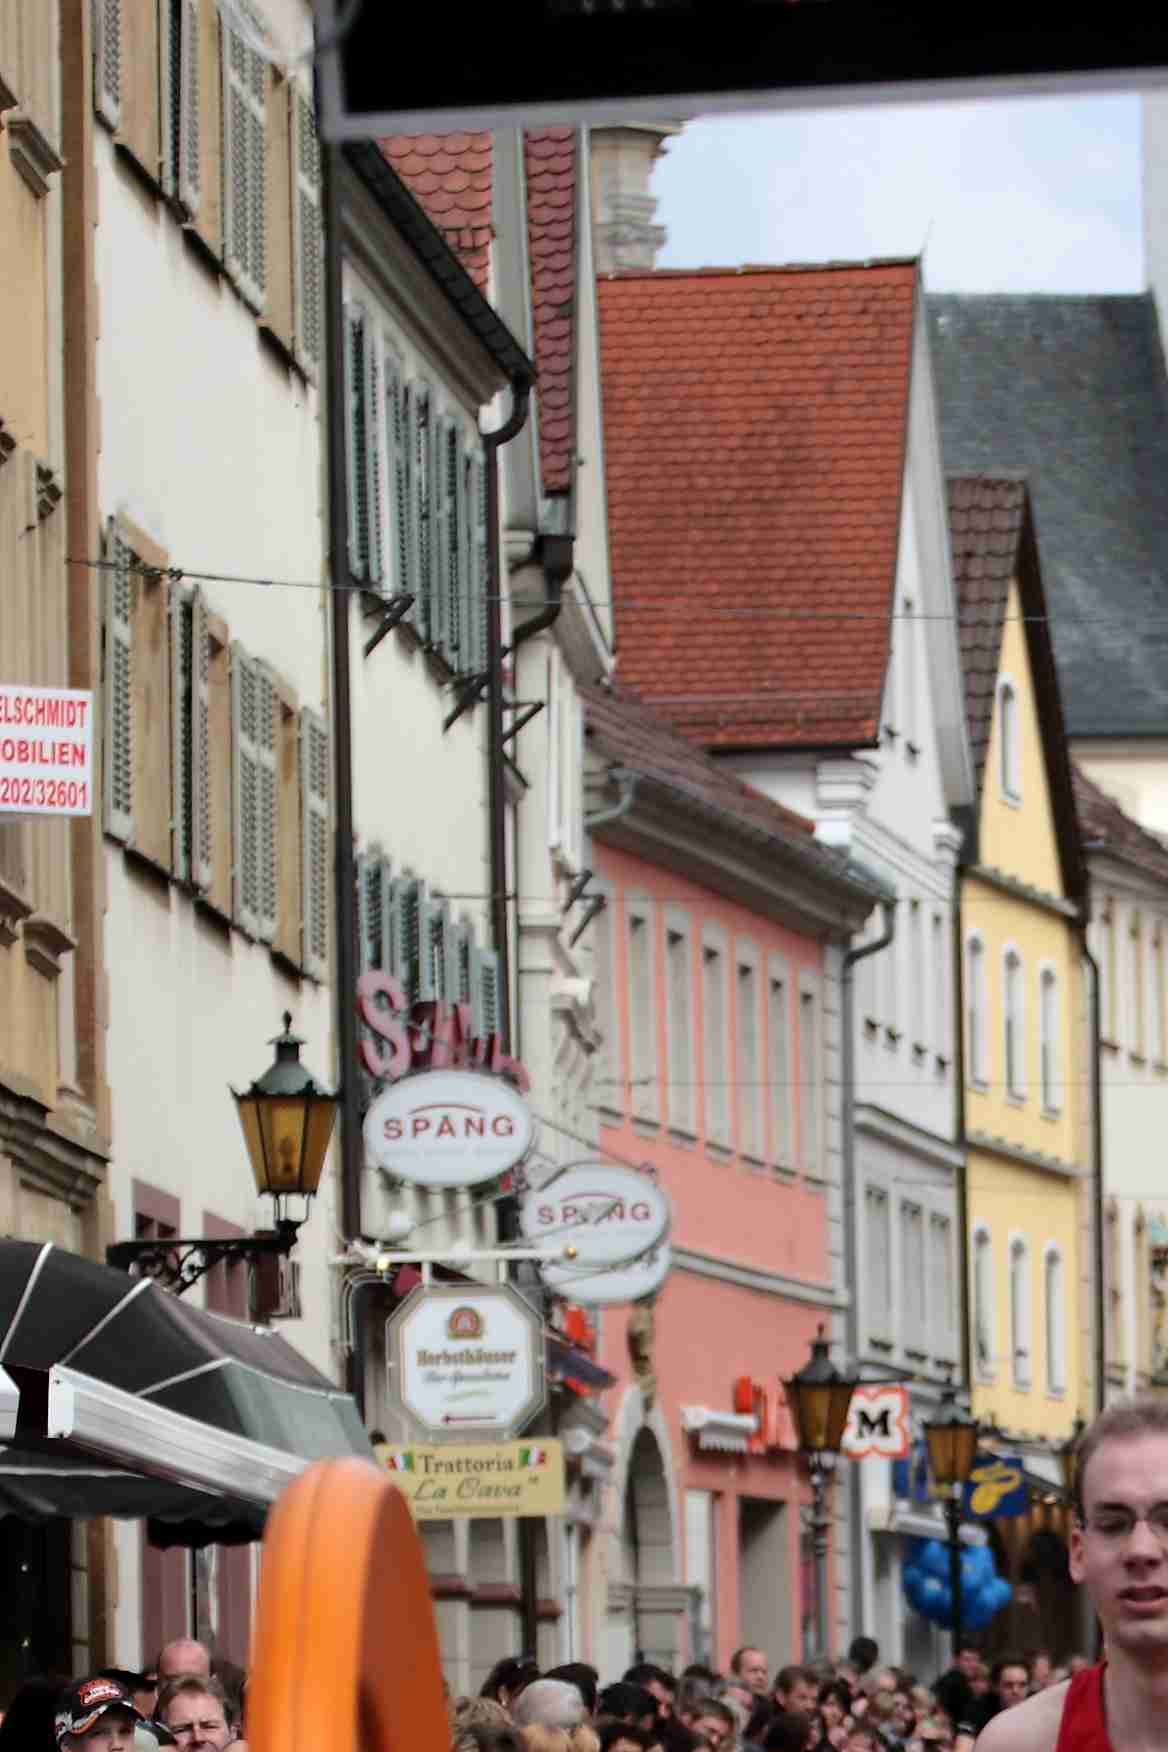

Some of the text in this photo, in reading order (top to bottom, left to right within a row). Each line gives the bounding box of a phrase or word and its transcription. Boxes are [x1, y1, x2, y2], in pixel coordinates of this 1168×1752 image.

[383, 1115, 514, 1140] SPANG
[537, 1201, 651, 1225] SPNG
[418, 1452, 513, 1474] Trattoria
